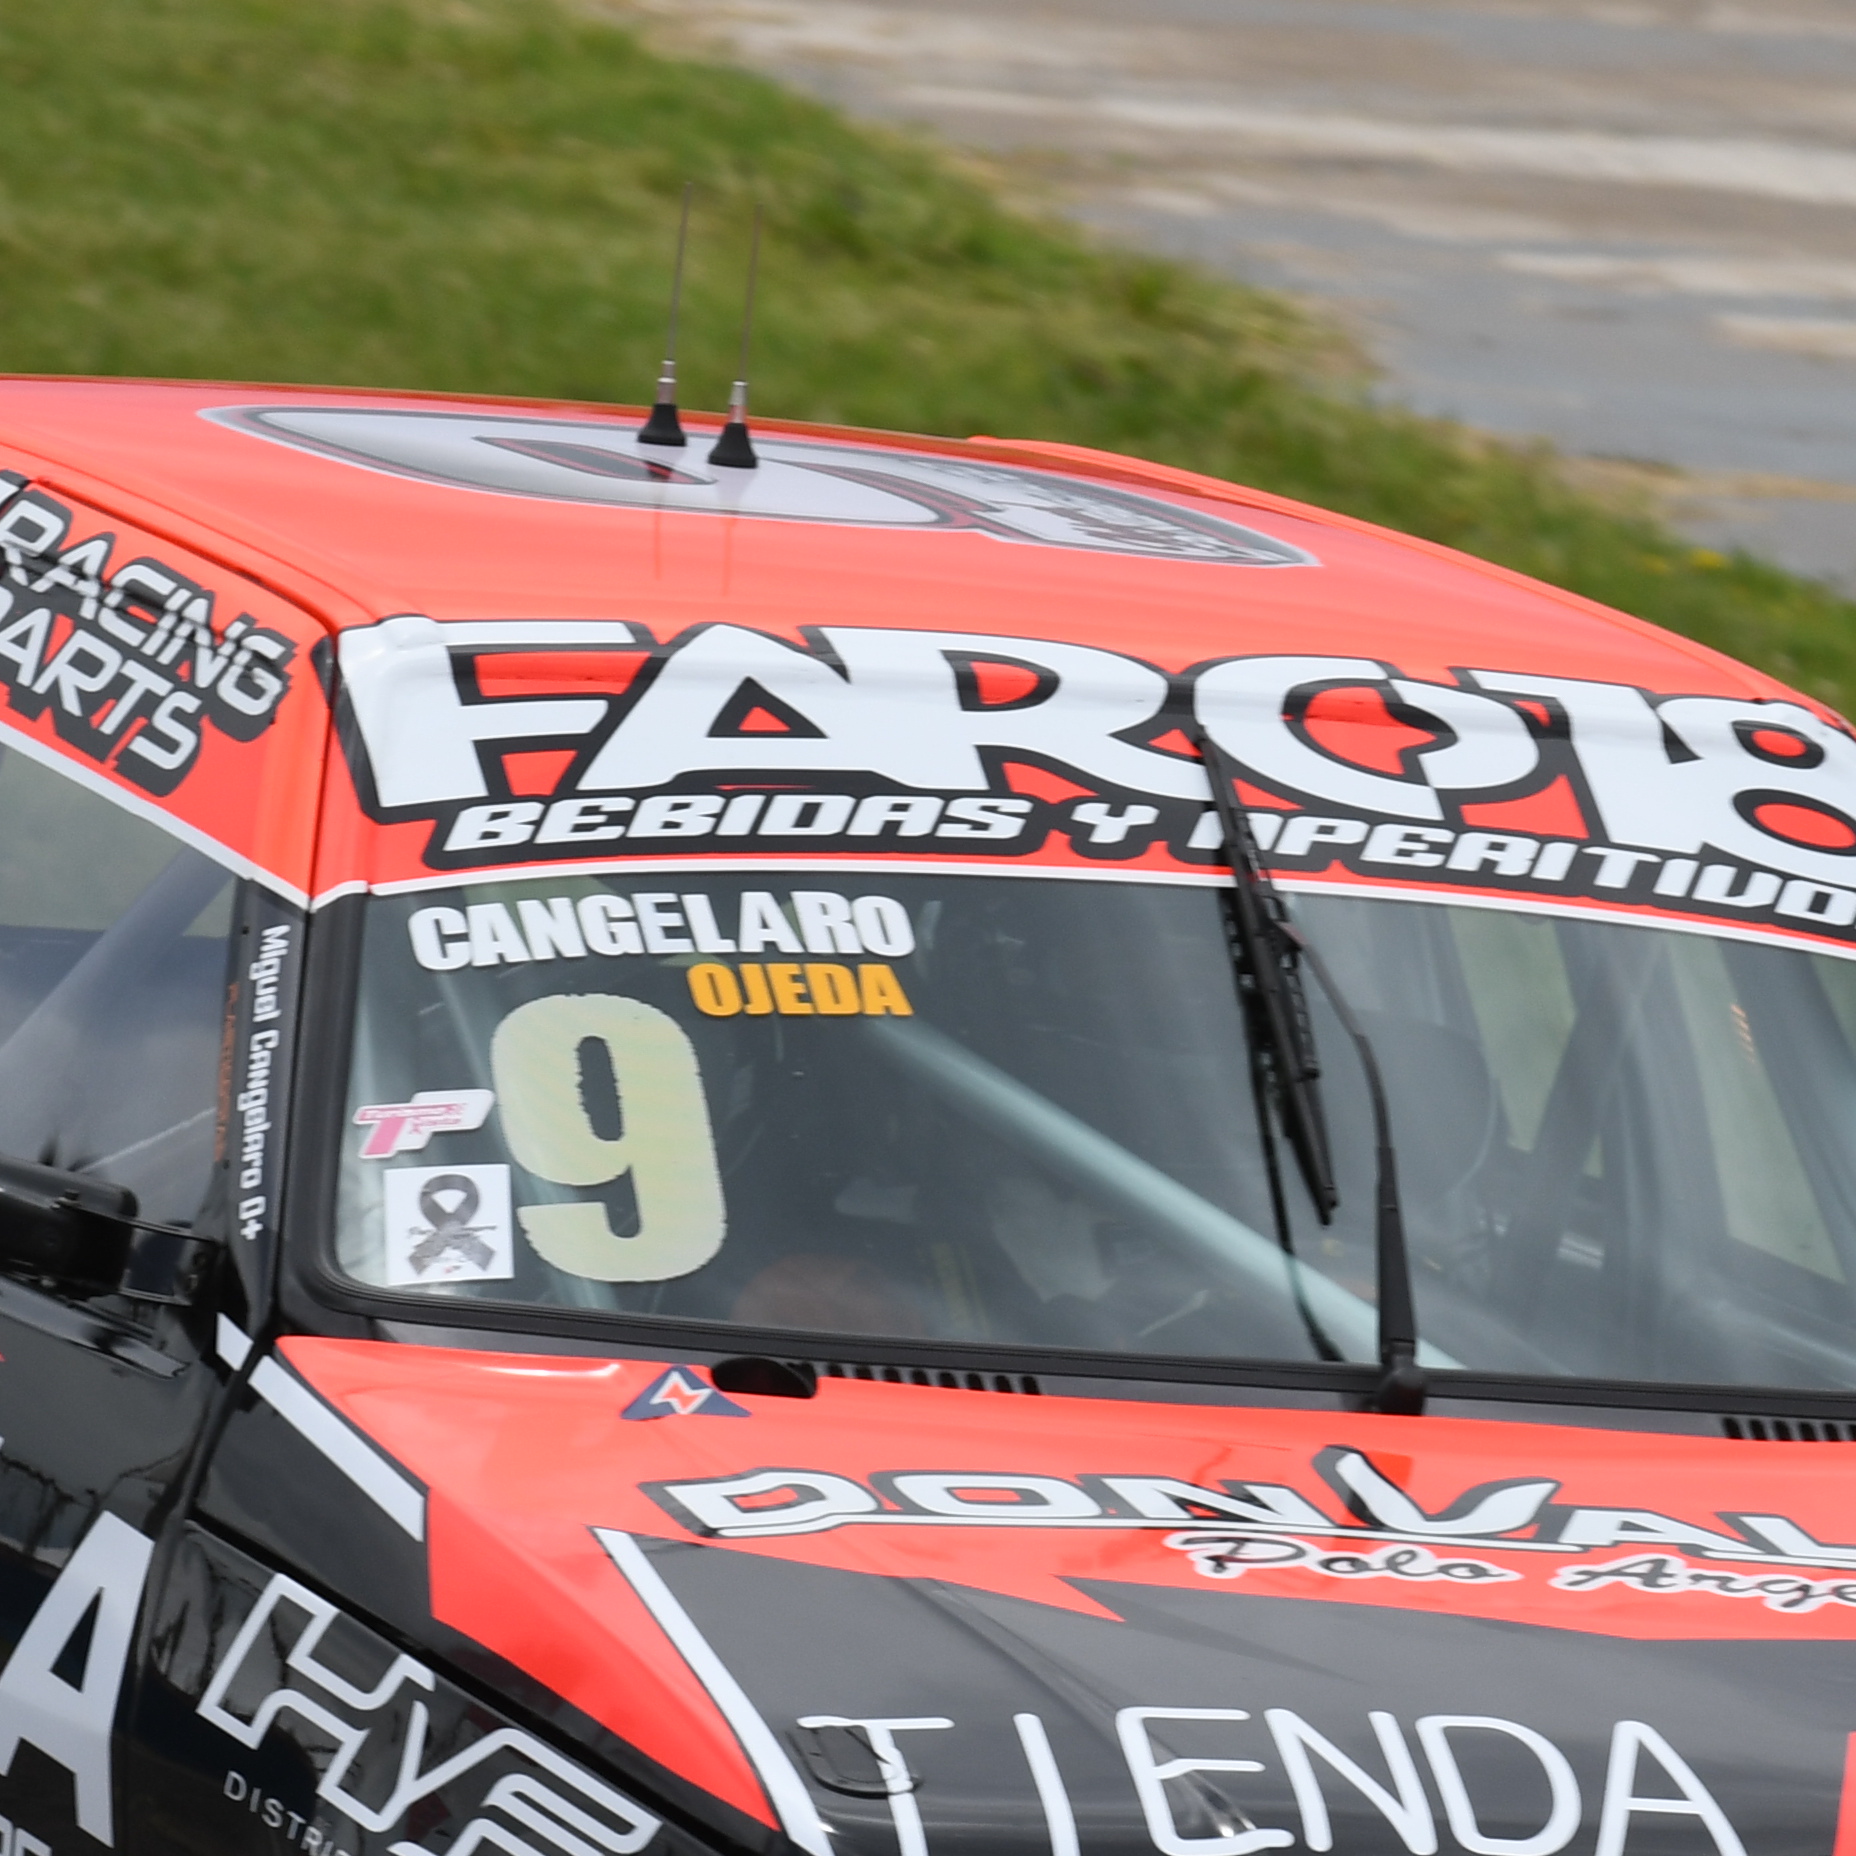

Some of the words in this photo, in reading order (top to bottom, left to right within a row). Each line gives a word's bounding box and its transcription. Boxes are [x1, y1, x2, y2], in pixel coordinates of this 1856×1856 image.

[443, 794, 1032, 852] BEBIDAS
[1070, 803, 1160, 844] Y
[408, 890, 915, 972] CANGELARO
[249, 924, 292, 1023] Miguel
[687, 963, 914, 1016] OJEDA
[490, 993, 727, 1283] 9
[1180, 1535, 1508, 1576] Polo
